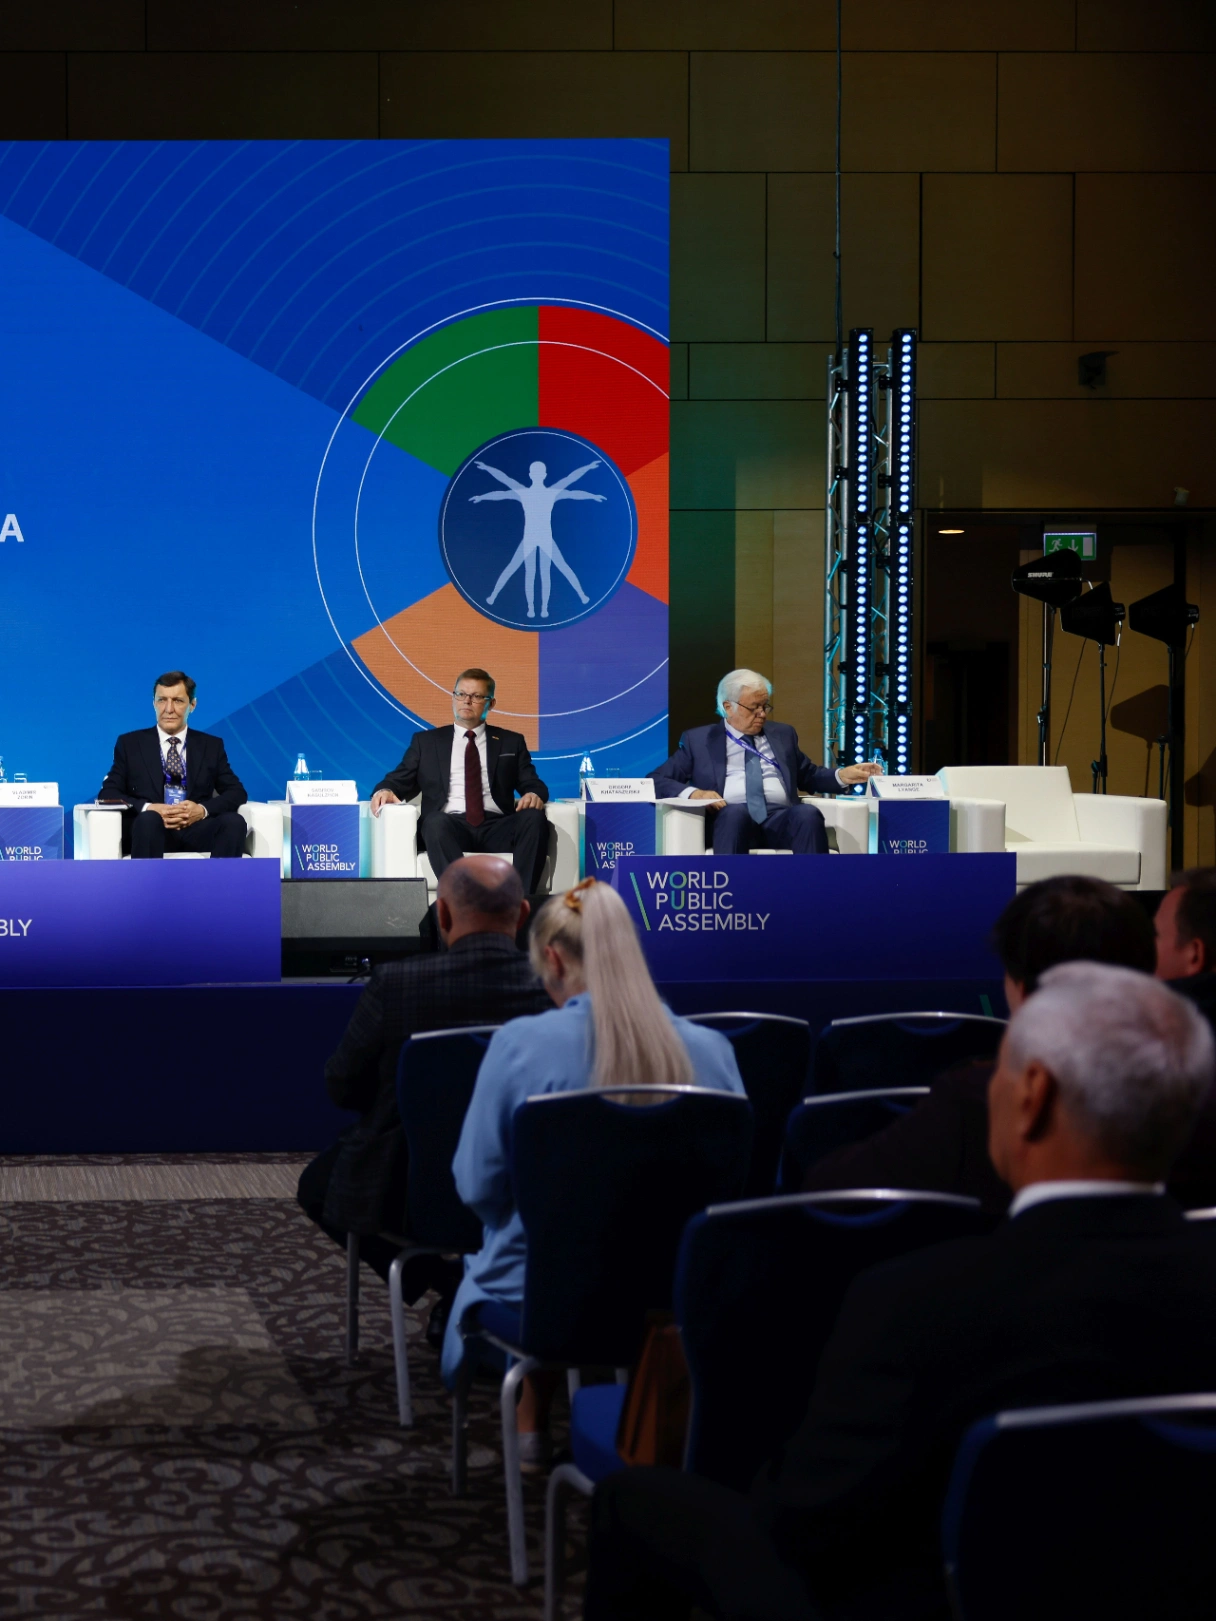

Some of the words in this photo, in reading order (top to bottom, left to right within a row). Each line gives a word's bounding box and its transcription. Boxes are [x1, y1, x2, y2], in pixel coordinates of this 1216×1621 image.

[302, 844, 338, 852] WORLD
[596, 842, 634, 850] WORLD
[889, 840, 927, 848] WORLD
[5, 846, 42, 855] WORLD
[306, 853, 340, 862] PUBLIC
[307, 862, 356, 871] ASSEMBLY
[647, 871, 729, 889] WORLD
[656, 890, 733, 910] PUBLIC
[658, 913, 770, 931] ASSEMBLY
